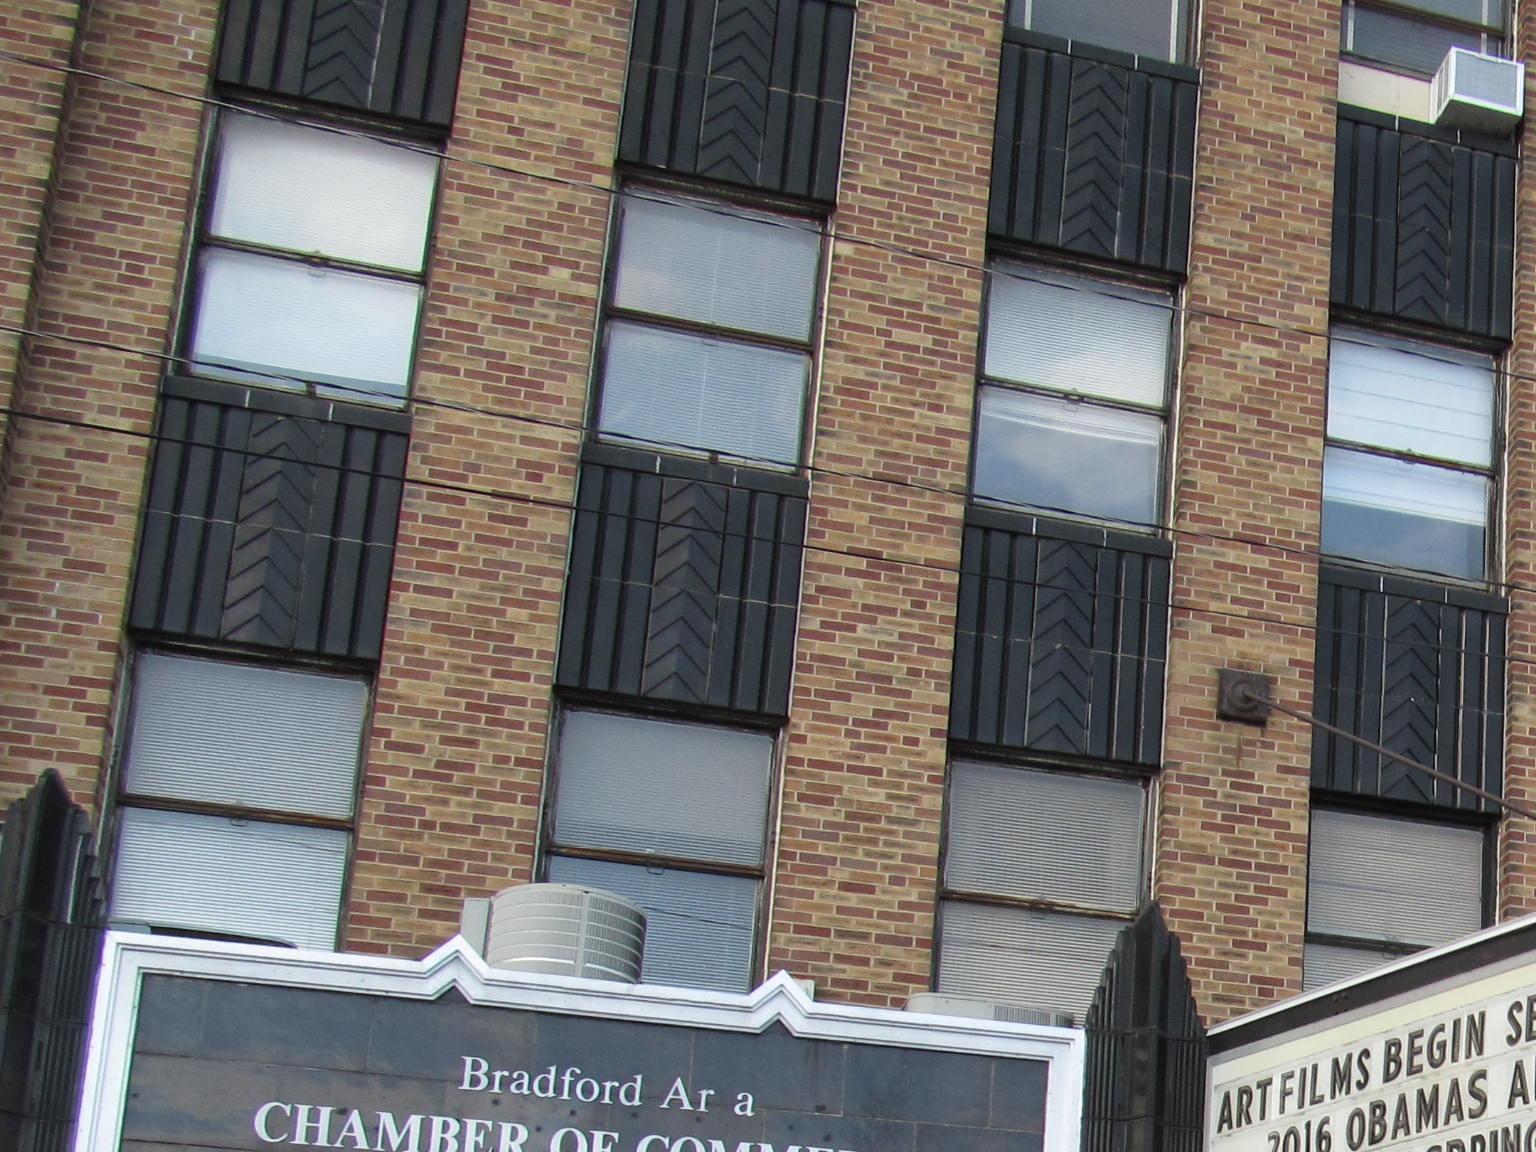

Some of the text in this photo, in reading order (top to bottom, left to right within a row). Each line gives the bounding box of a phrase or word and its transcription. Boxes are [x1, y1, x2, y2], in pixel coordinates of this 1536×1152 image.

[458, 1055, 643, 1107] Bradford
[1382, 1011, 1486, 1083] BEGIN
[1346, 1068, 1488, 1151] OBAMAS
